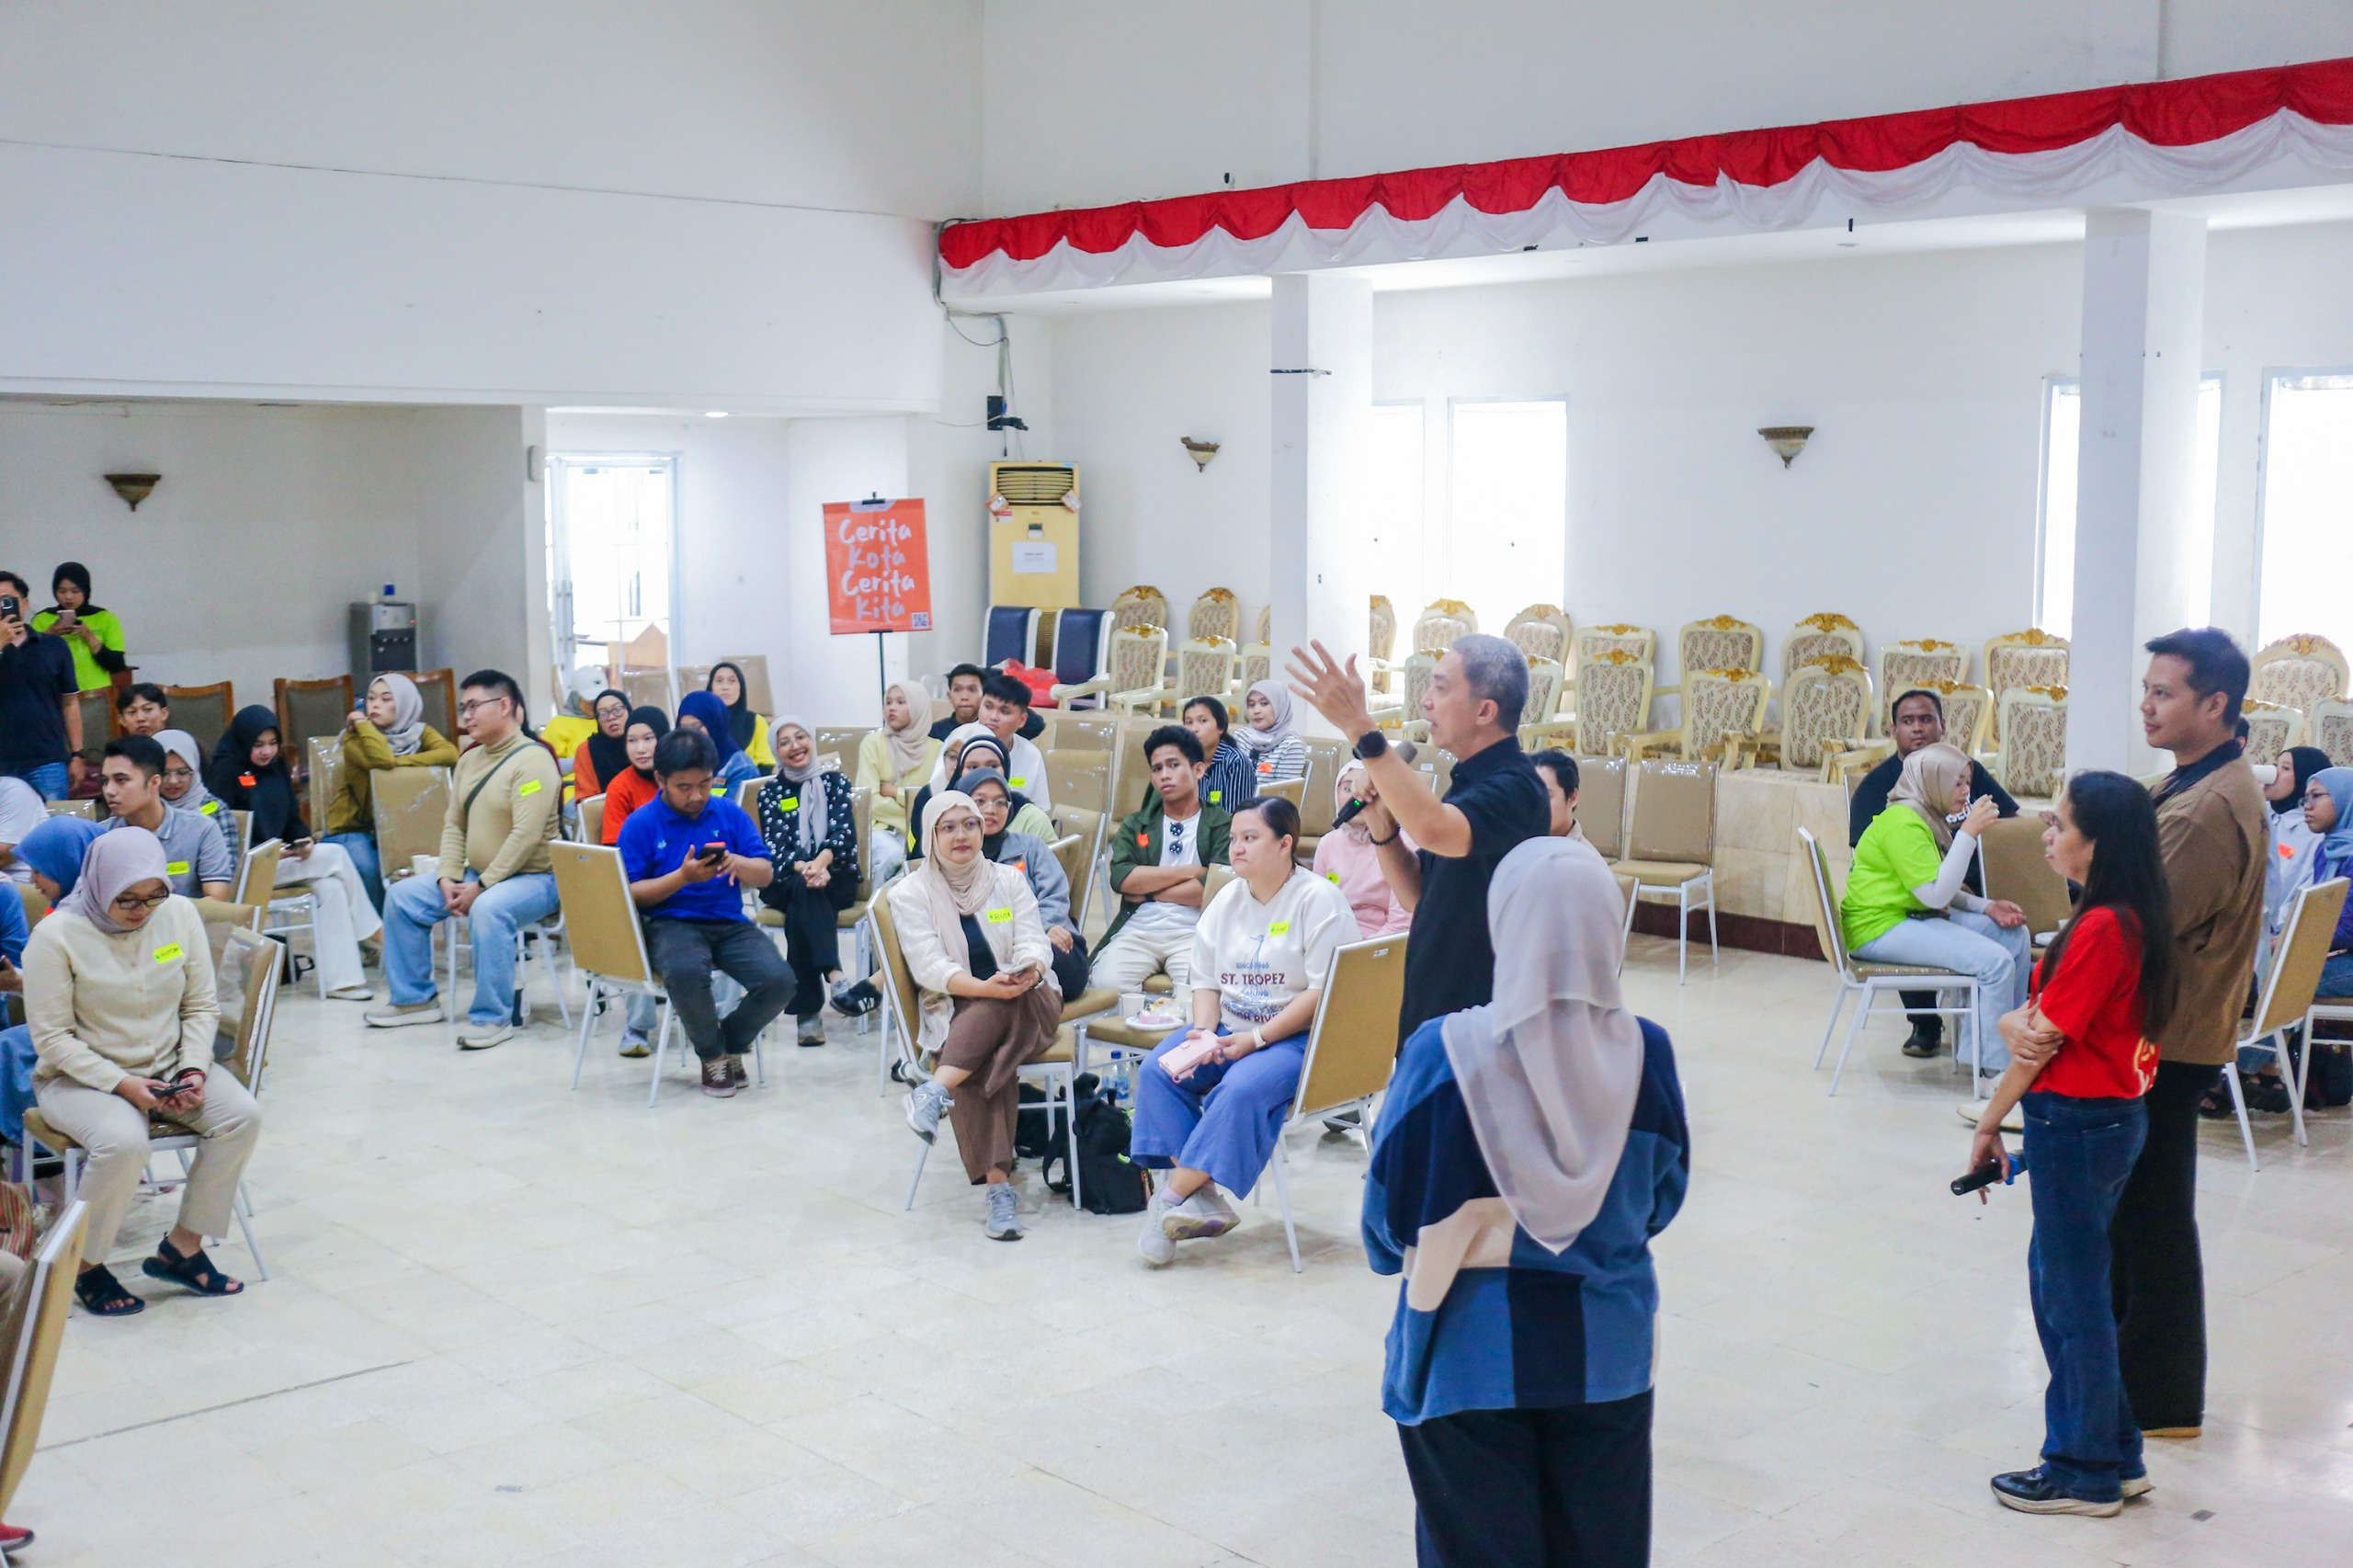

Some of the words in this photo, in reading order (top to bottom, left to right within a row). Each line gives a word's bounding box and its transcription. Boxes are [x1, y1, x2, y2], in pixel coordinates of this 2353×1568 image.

[838, 518, 912, 546] Cerita
[849, 544, 905, 572] Kota
[841, 569, 915, 597] Cerita
[856, 596, 905, 624] Kita
[1221, 973, 1238, 984] ST.
[1242, 973, 1285, 985] TROPEZ
